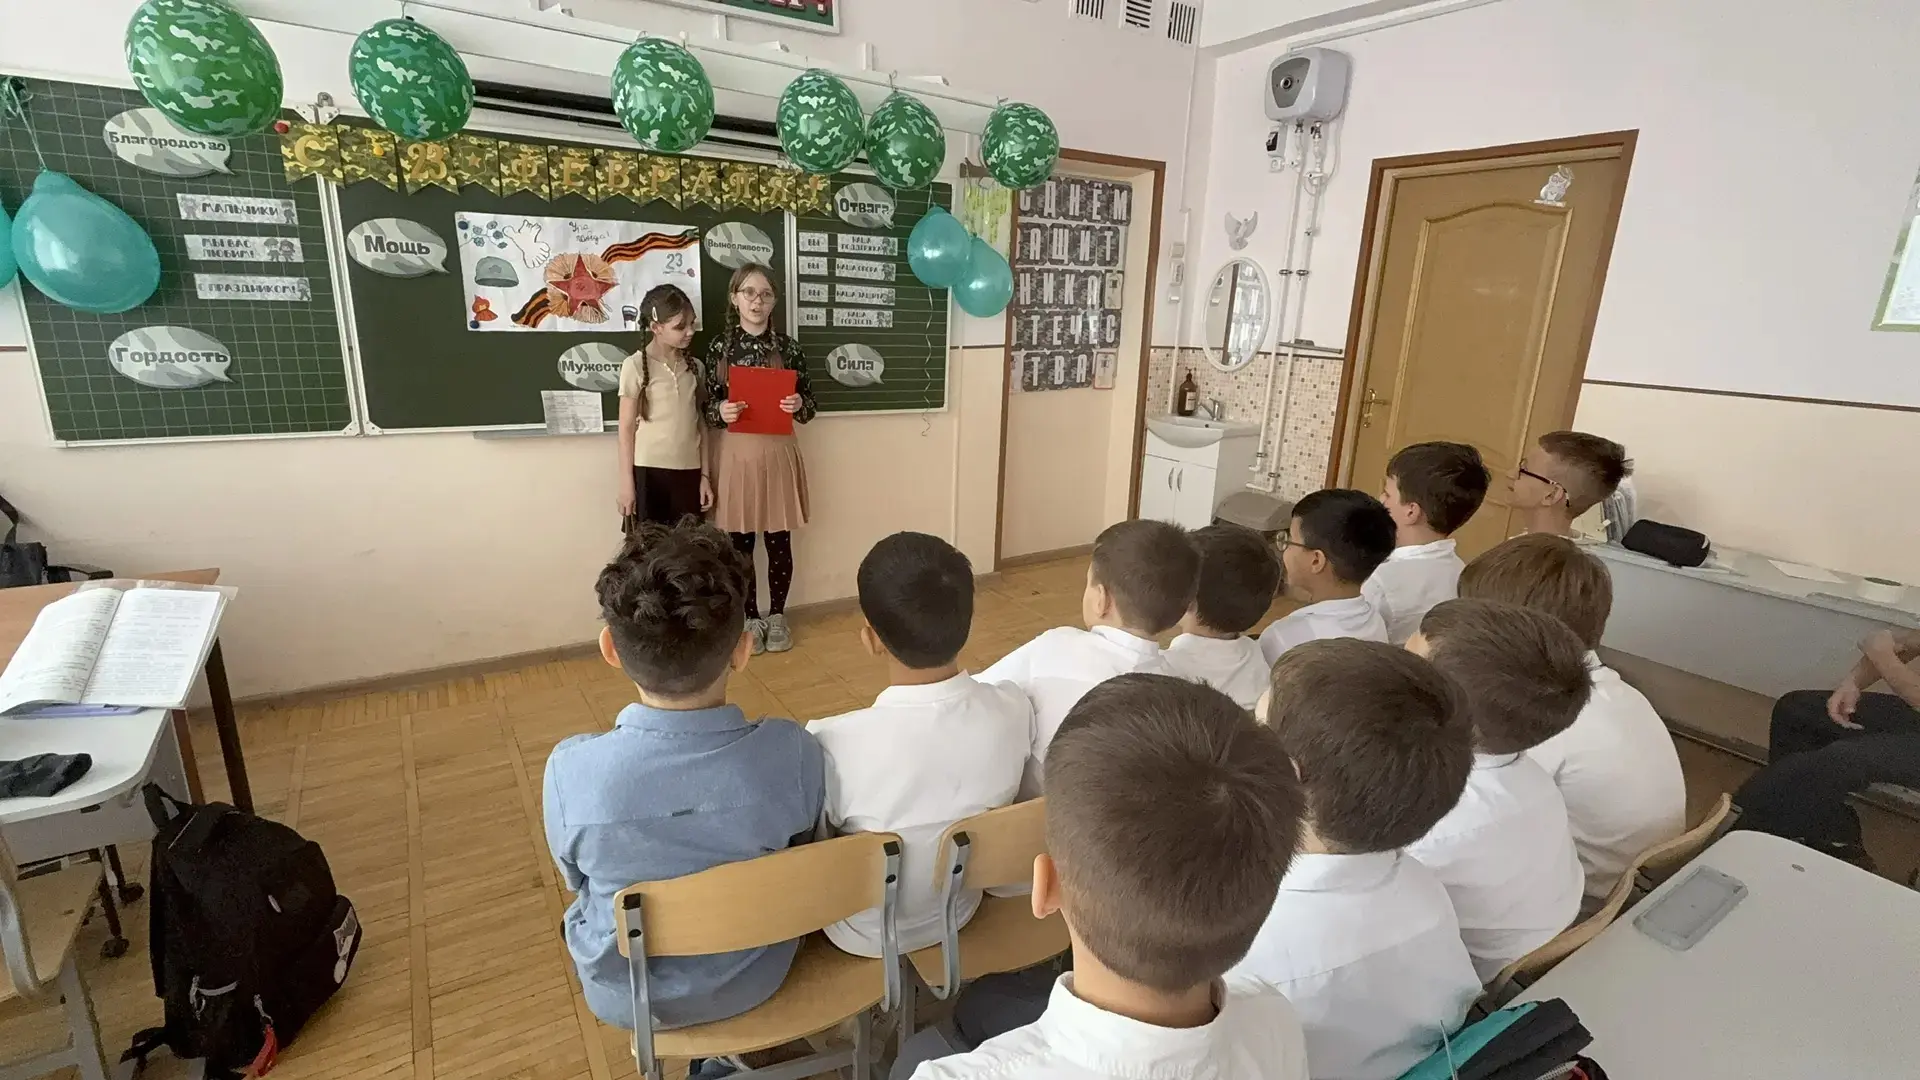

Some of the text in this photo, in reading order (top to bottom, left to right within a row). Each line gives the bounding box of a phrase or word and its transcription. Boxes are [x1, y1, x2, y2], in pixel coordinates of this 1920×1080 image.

[107, 131, 226, 152] Благородство
[294, 135, 326, 168] С
[407, 143, 447, 180] 23
[201, 202, 279, 216] МАЛЬЧИКИ
[839, 198, 889, 215] Отвага
[1044, 180, 1128, 221] ДНЁМ
[364, 234, 431, 255] Мощь
[707, 239, 771, 252] Выносливость
[666, 252, 683, 270] 23
[209, 283, 296, 294] ПРАЗДНИКОМ!
[1019, 272, 1101, 305] НИКА
[115, 347, 229, 366] Гордость
[836, 355, 874, 371] Сила
[561, 360, 622, 375] Мужест
[1031, 353, 1088, 386] ТВА
